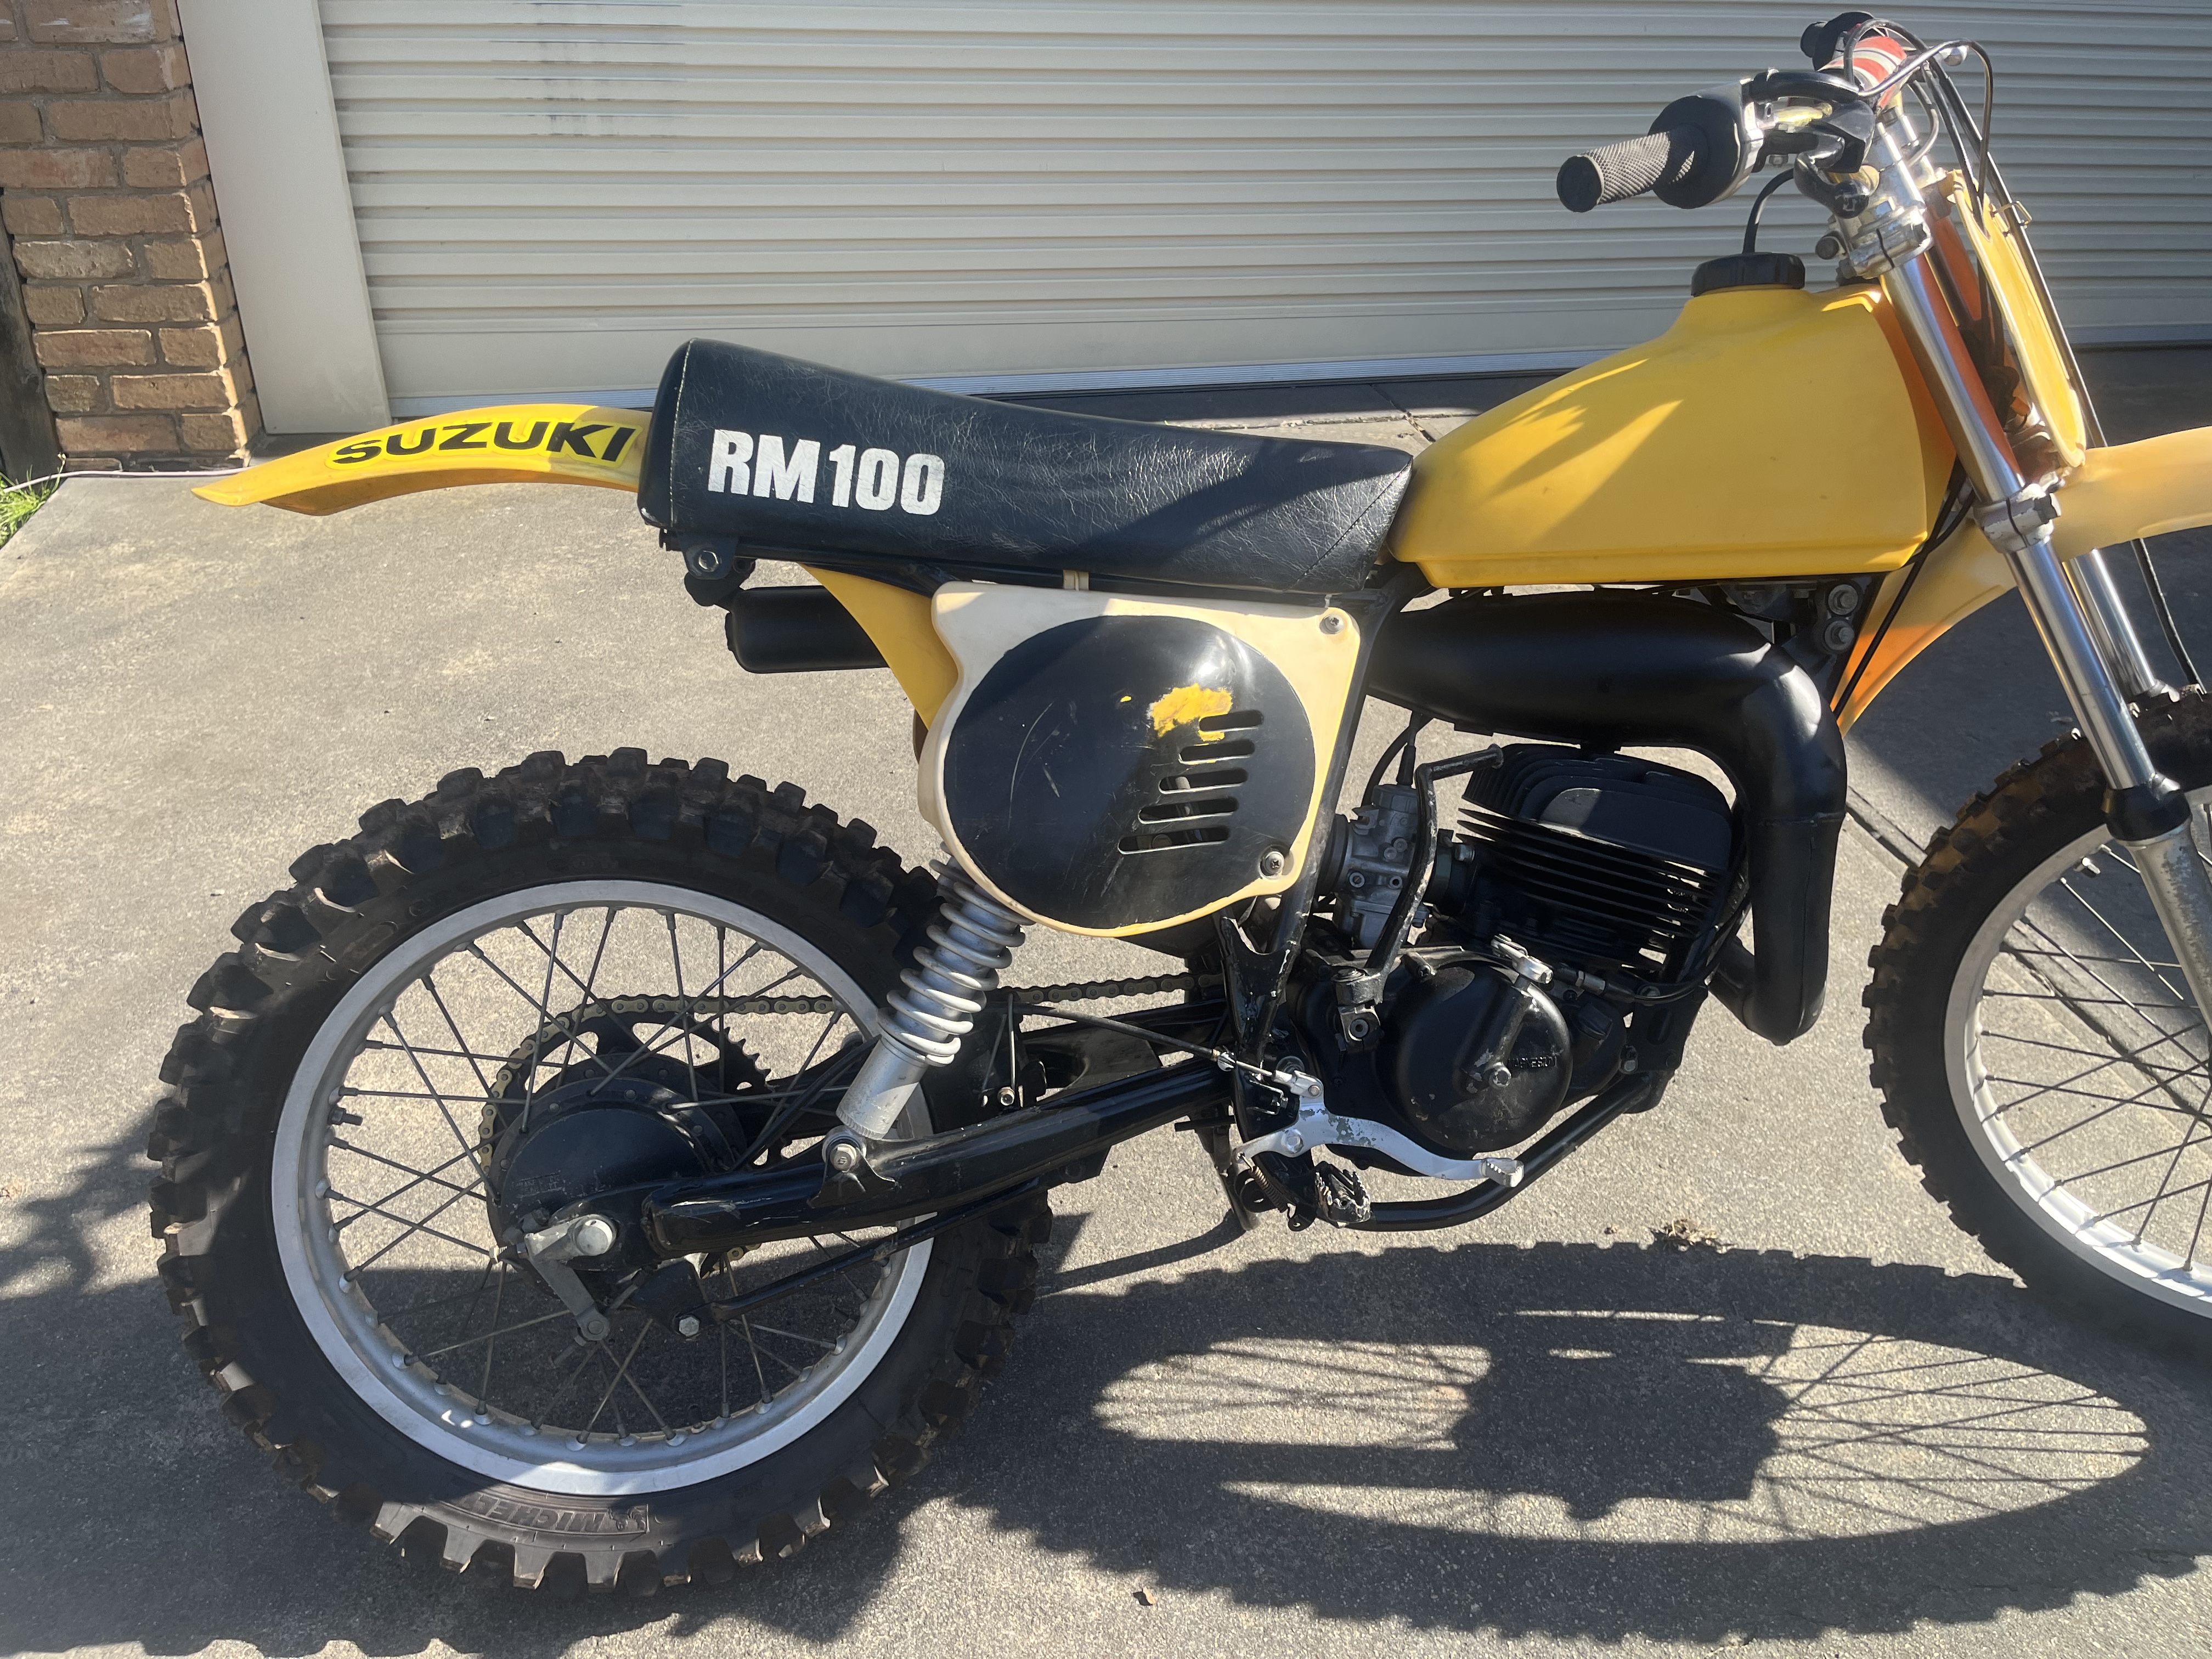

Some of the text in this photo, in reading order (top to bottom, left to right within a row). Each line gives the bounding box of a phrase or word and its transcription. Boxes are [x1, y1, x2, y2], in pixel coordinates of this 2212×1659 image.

[331, 421, 635, 465] SUZUKI
[708, 429, 945, 516] RM 100
